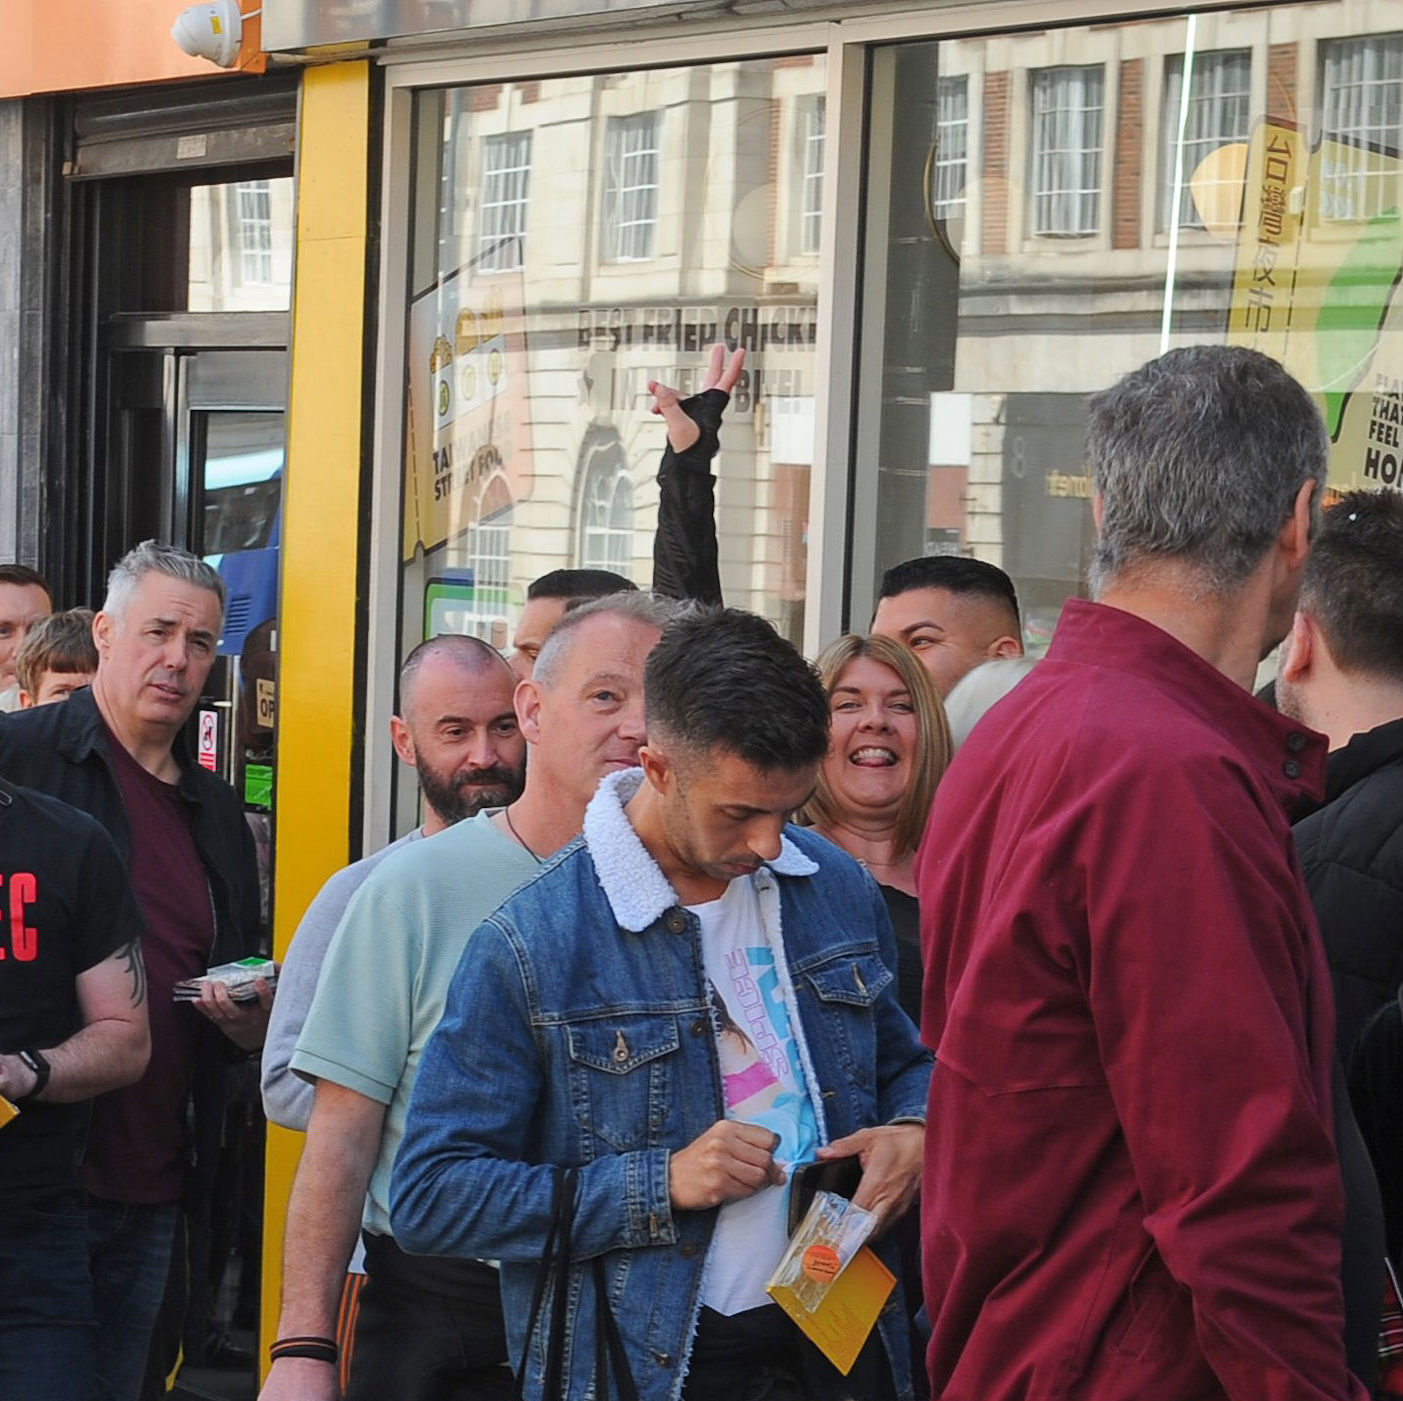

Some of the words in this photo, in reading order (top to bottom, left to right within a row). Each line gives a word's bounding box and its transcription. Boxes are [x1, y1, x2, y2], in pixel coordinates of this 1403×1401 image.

[643, 308, 718, 351] FRIED
[1368, 420, 1400, 448] FEEL
[9, 872, 37, 962] C
